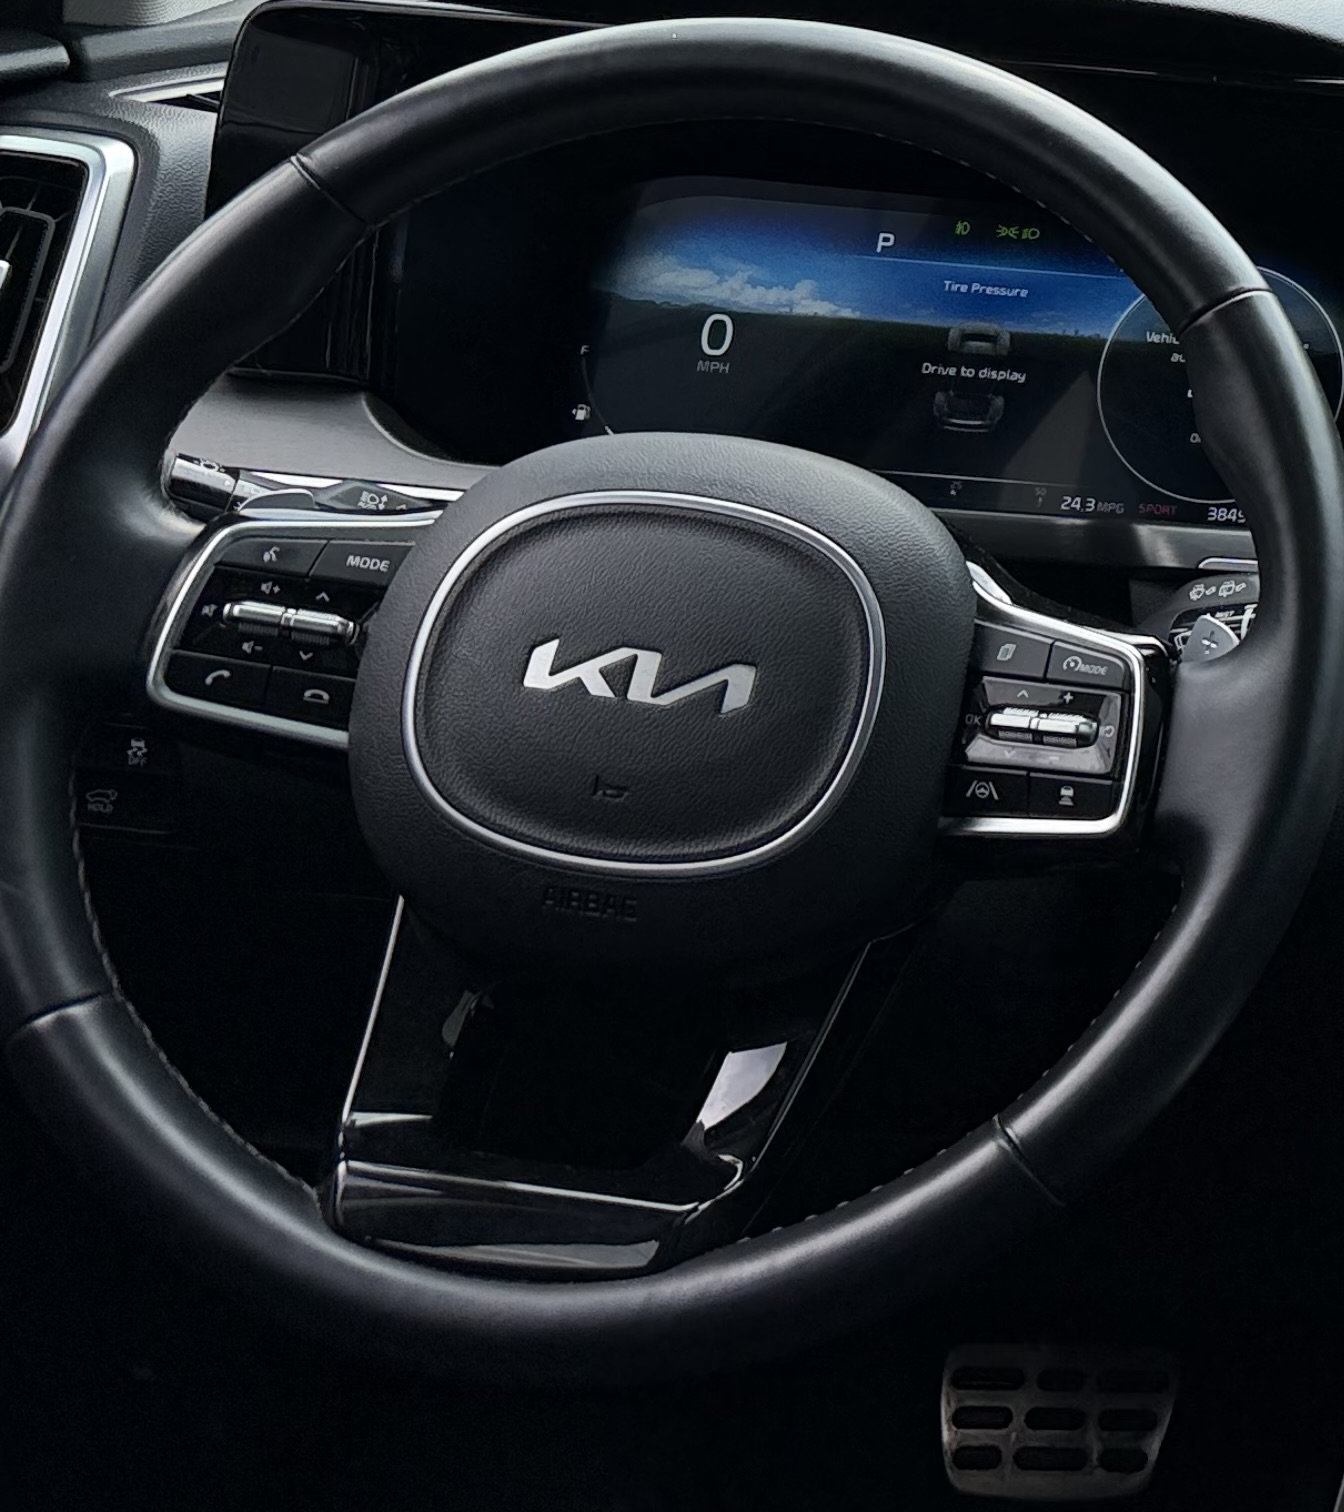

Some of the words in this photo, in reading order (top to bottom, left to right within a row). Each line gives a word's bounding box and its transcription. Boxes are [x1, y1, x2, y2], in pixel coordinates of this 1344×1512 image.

[877, 233, 895, 252] P
[944, 280, 968, 293] Tire
[971, 282, 1028, 298] Pressure
[701, 313, 734, 356] 0
[580, 345, 590, 356] F
[696, 360, 730, 374] MPH
[922, 363, 957, 376] Drive
[960, 365, 975, 378] to
[979, 367, 1026, 384] display
[1061, 496, 1096, 513] 24.3
[1097, 502, 1125, 514] MPG
[1138, 502, 1178, 515] SPORT
[346, 554, 390, 573] MODE
[523, 638, 757, 714] KIA
[1079, 662, 1107, 677] MODE
[965, 714, 983, 727] OK
[541, 887, 638, 922] AIRBAG
